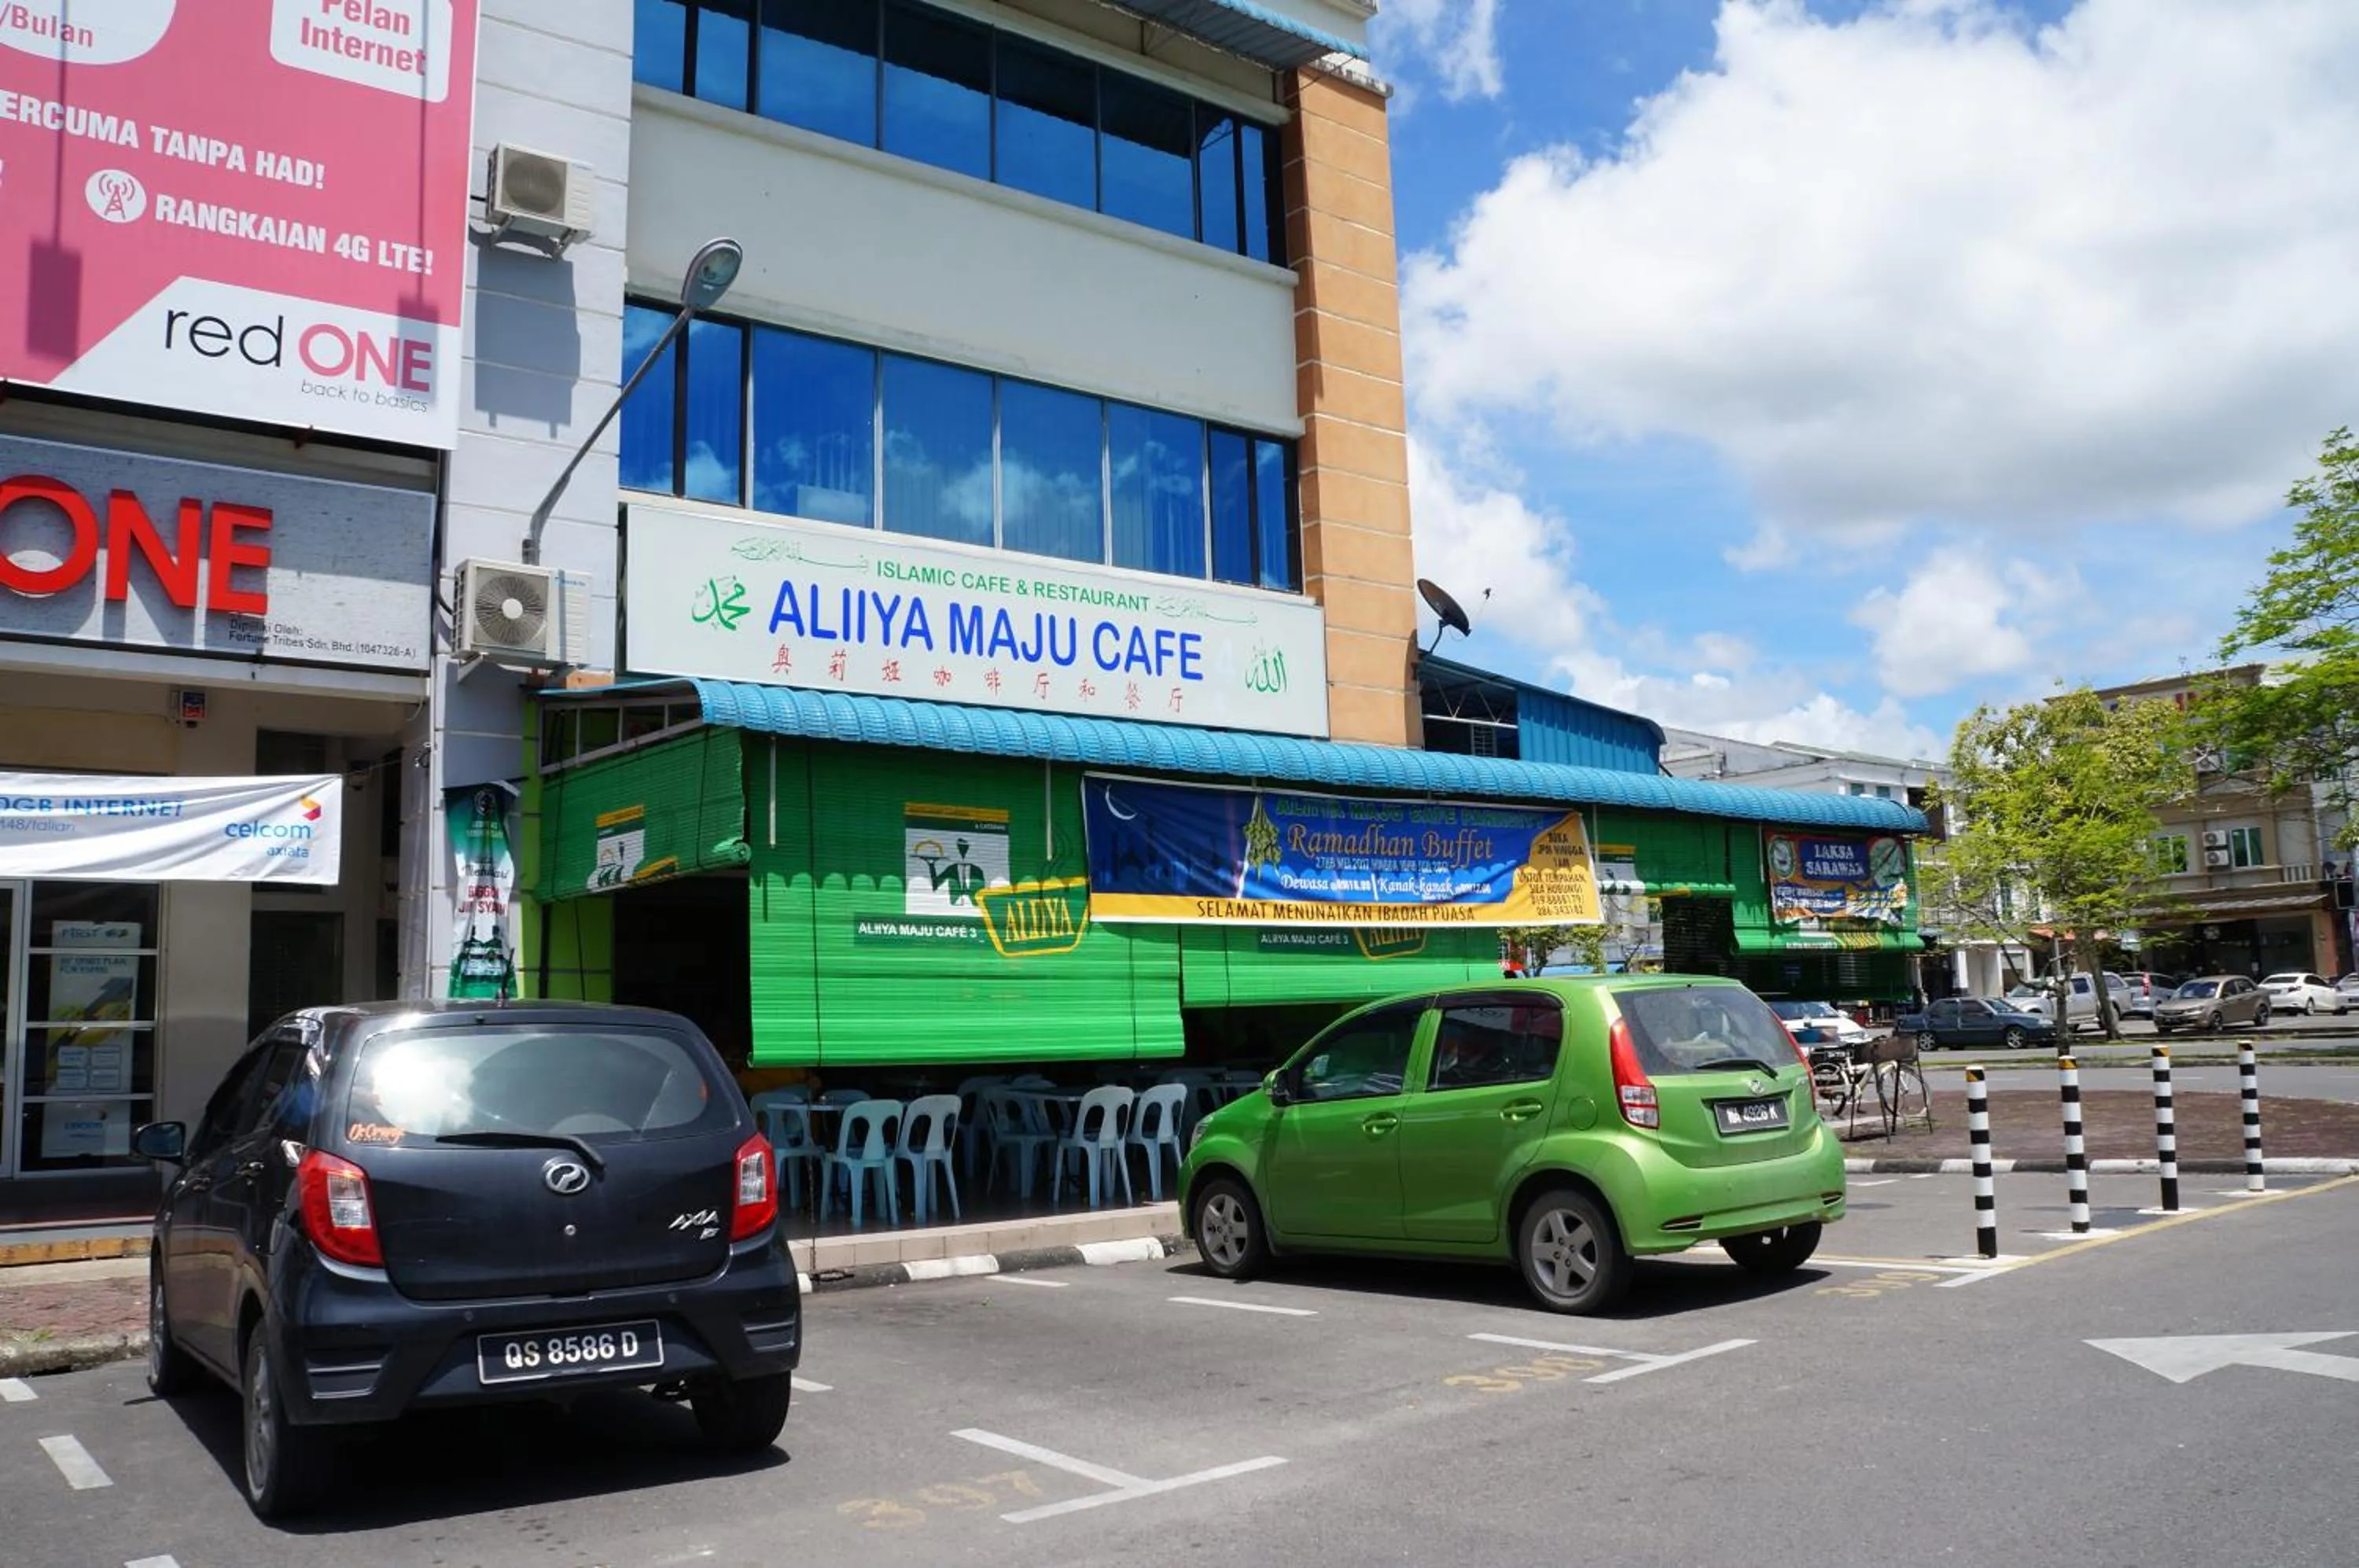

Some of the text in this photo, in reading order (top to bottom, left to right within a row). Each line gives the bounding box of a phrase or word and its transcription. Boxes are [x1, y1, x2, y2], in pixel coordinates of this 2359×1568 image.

[0, 2, 94, 48] /Bulan
[300, 17, 427, 76] Internet
[150, 125, 246, 173] TANPA
[256, 150, 326, 190] HAD!
[156, 194, 433, 275] RANGKAIAN 4G LTE!
[165, 309, 432, 392] red ONE
[301, 379, 427, 414] back to basics
[0, 474, 273, 614] ONE
[877, 560, 956, 587] ISLAMIC
[961, 572, 1010, 594] CAFE
[1016, 579, 1029, 596] &
[1033, 581, 1151, 613] RESTAURANT
[229, 630, 269, 643] Fortune
[274, 635, 304, 648] Tribes
[332, 640, 354, 653] Bhd.
[768, 579, 1204, 681] ALIIYA MAJU CAFE
[64, 796, 185, 819] INTERNET
[224, 821, 312, 841] celcom
[1287, 823, 1493, 869] Ramadhan Buffet
[267, 845, 309, 859] axiata
[1805, 860, 1865, 876] SARAWAK
[1814, 844, 1855, 860] LAKSA
[1280, 874, 1330, 890] Dewasa
[1005, 896, 1075, 943] ALIIYA
[1196, 900, 1475, 922] SELAMAT MENUNAIKAN IBADAH PUASA
[858, 922, 898, 935] ALIIYA
[899, 923, 933, 937] MAJU
[969, 927, 977, 938] 3
[1290, 933, 1316, 944] MAJU
[668, 1209, 719, 1231] AXIA
[505, 1331, 639, 1369] QS 8586 D
